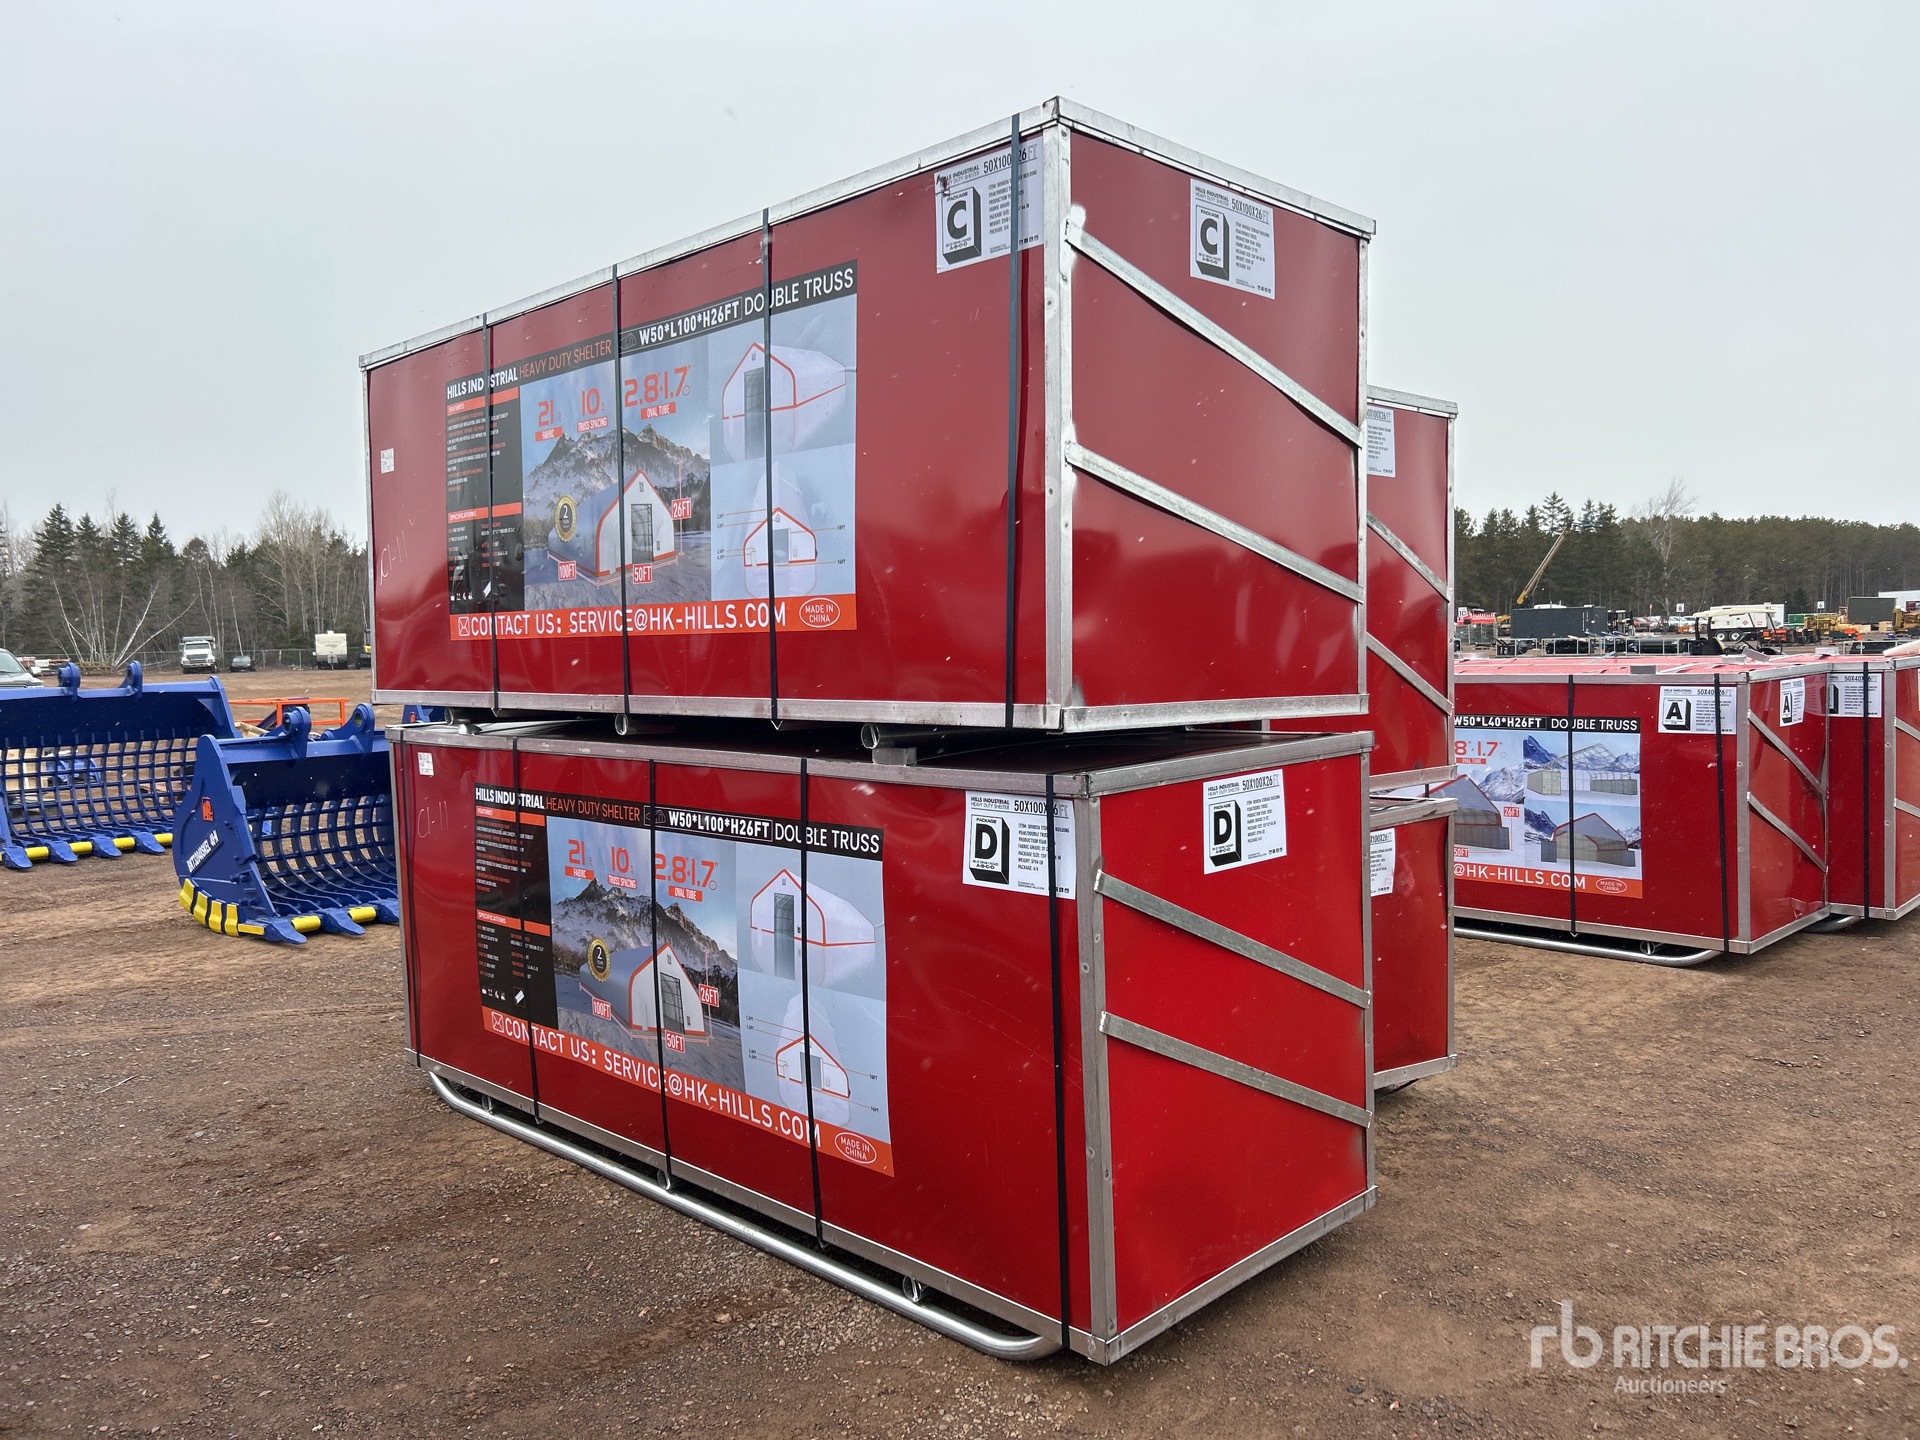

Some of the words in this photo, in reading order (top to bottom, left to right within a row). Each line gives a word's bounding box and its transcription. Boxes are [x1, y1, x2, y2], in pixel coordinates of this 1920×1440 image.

[953, 165, 980, 178] INDUSTRIAL
[947, 192, 968, 202] PACKAGE
[1206, 189, 1228, 202] INDUSTRIAL
[947, 200, 968, 240] C
[1200, 209, 1220, 218] PACKAGE
[1200, 218, 1218, 255] C
[804, 268, 854, 300] TRUSS
[447, 384, 467, 400] HILLS
[468, 367, 518, 392] INDSTRIAL
[520, 359, 547, 378] HEAVY
[548, 352, 572, 371] DUTY
[574, 339, 612, 364] SHELTER
[581, 388, 600, 417] 10
[538, 400, 554, 428] 21
[564, 505, 568, 518] 2
[673, 499, 691, 518] 26FT
[634, 566, 651, 582] 50FT
[806, 604, 824, 614] MADE
[826, 604, 834, 612] IN
[471, 614, 530, 636] CONTACT
[535, 612, 562, 634] US:
[809, 614, 830, 623] CHINA
[1666, 702, 1682, 720] A
[1783, 696, 1790, 713] A
[1599, 719, 1638, 731] TRUSS
[1219, 782, 1240, 790] INDUSTRIAL
[476, 788, 494, 802] HILLS
[546, 797, 576, 813] HEAVY
[578, 800, 600, 816] DUTY
[602, 803, 640, 822] SHELTER
[1504, 808, 1520, 817] 26FT
[1214, 810, 1232, 846] D
[774, 822, 828, 847] DOUBLE
[832, 830, 880, 854] TRUSS
[974, 823, 998, 860] D
[568, 839, 586, 866] 21
[610, 846, 630, 874] 10
[596, 946, 602, 960] 2
[700, 988, 718, 1006] 26FT
[593, 1000, 610, 1018] 100FT
[505, 1018, 566, 1054] CONTACT
[570, 1038, 597, 1066] US:
[666, 1034, 684, 1051] 50FT
[840, 1138, 861, 1150] MADE
[862, 1144, 870, 1152] IN
[845, 1147, 868, 1160] CHINA
